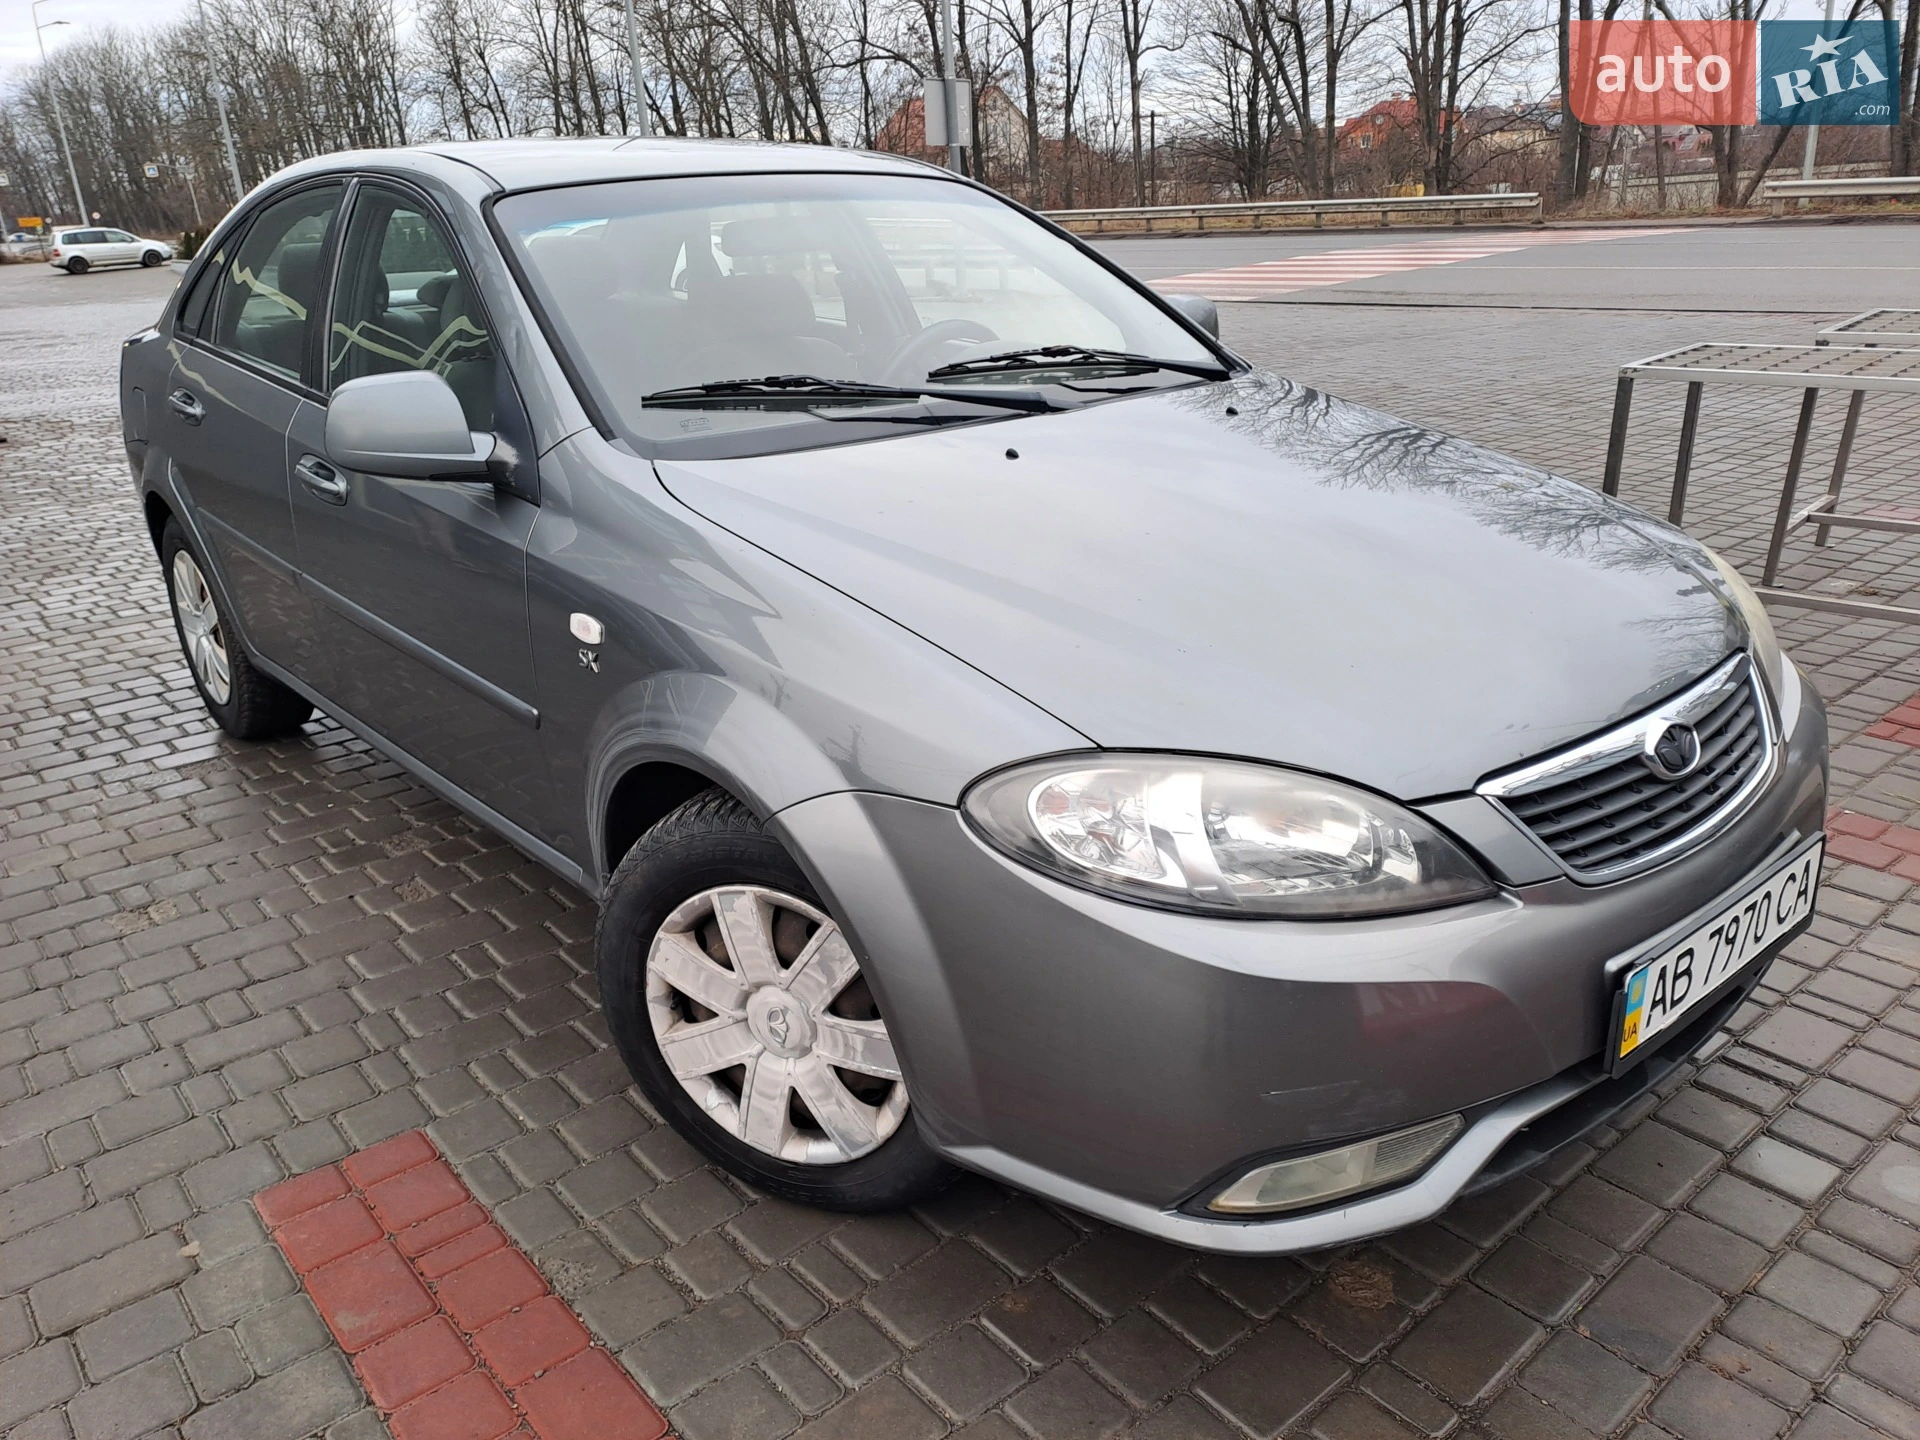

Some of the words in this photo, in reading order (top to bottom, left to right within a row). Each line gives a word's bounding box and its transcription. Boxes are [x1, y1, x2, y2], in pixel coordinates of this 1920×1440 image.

[1645, 947, 1695, 1029] AB
[1703, 890, 1772, 986] 7970
[1776, 858, 1812, 926] CA
[1622, 1022, 1638, 1043] UA
